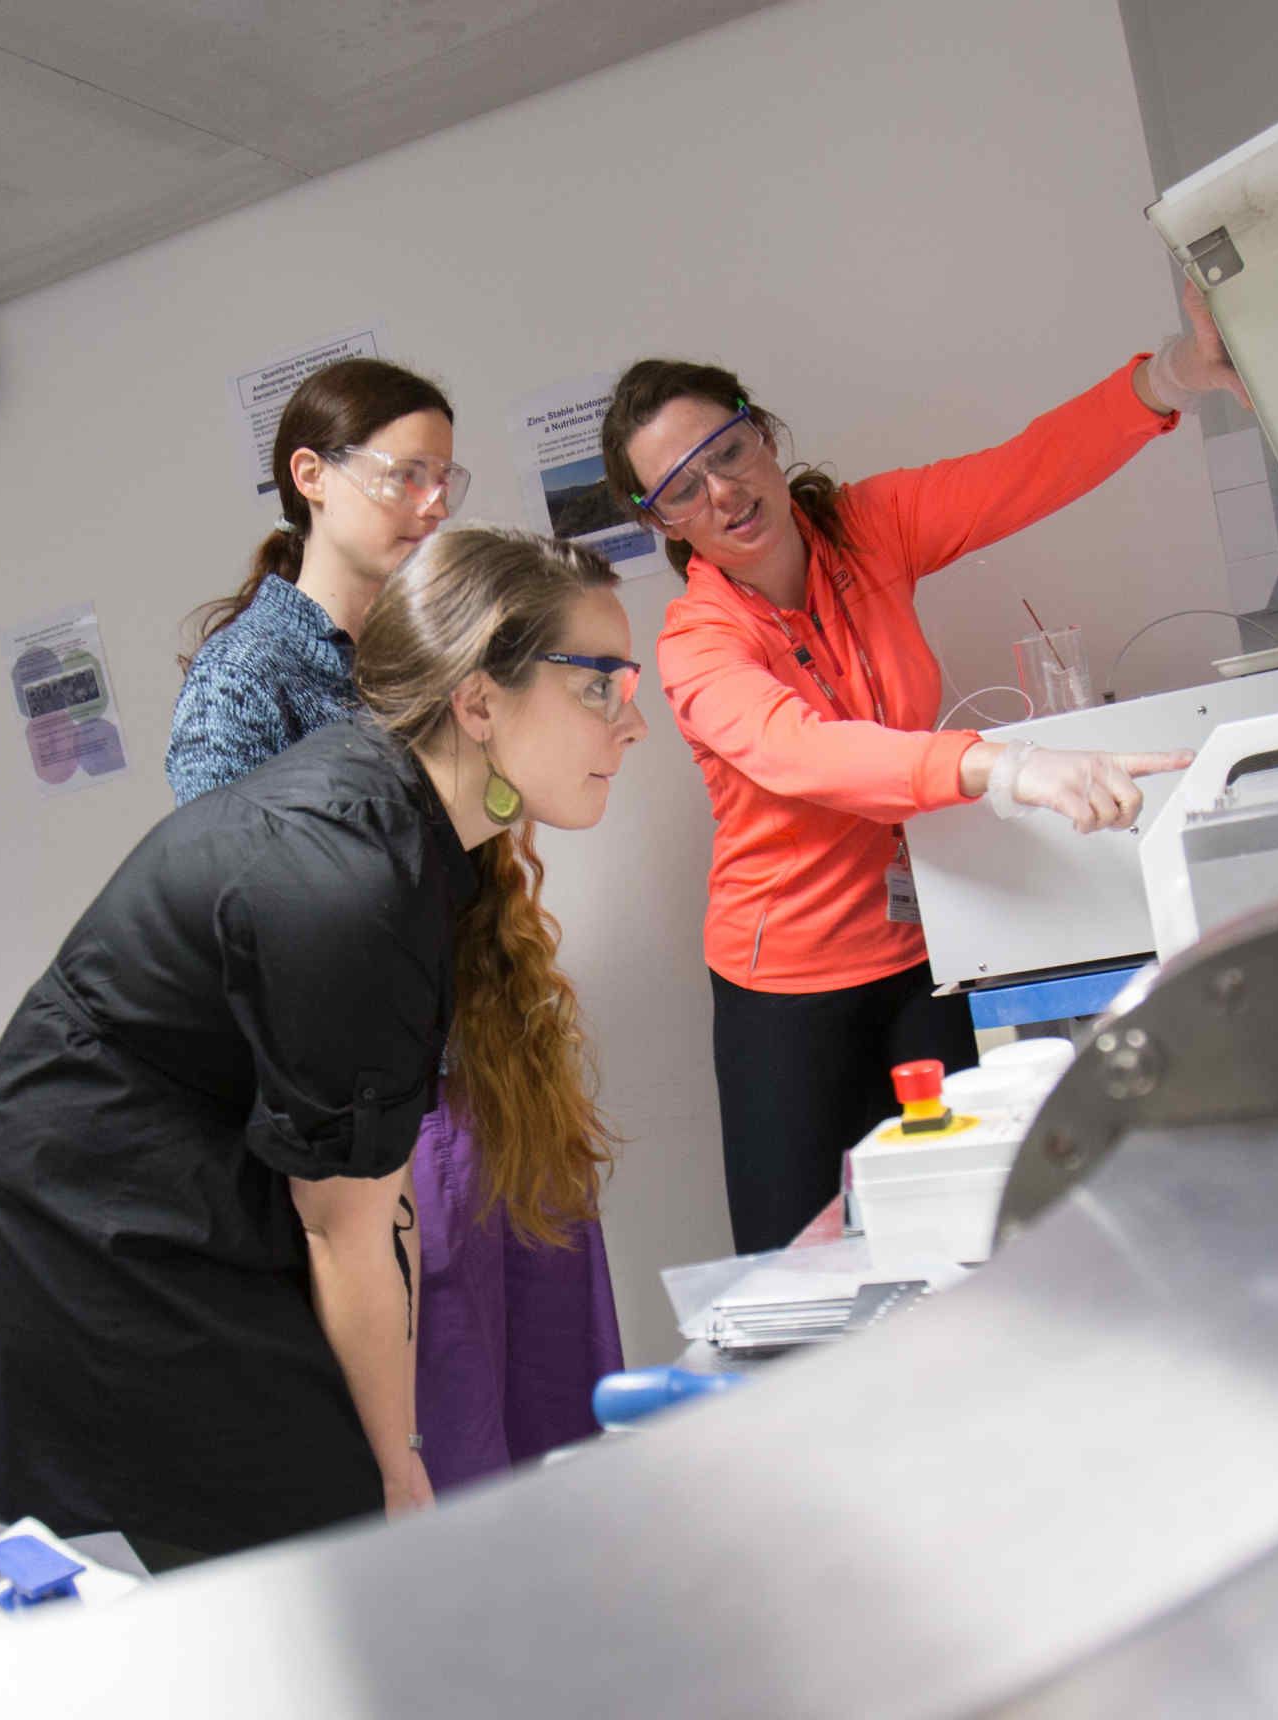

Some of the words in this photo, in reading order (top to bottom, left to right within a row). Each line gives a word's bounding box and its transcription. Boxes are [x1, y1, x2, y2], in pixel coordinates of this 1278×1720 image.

[295, 359, 306, 368] the
[527, 414, 546, 427] Zinc
[547, 406, 574, 421] Stable
[551, 413, 594, 432] Nutritious
